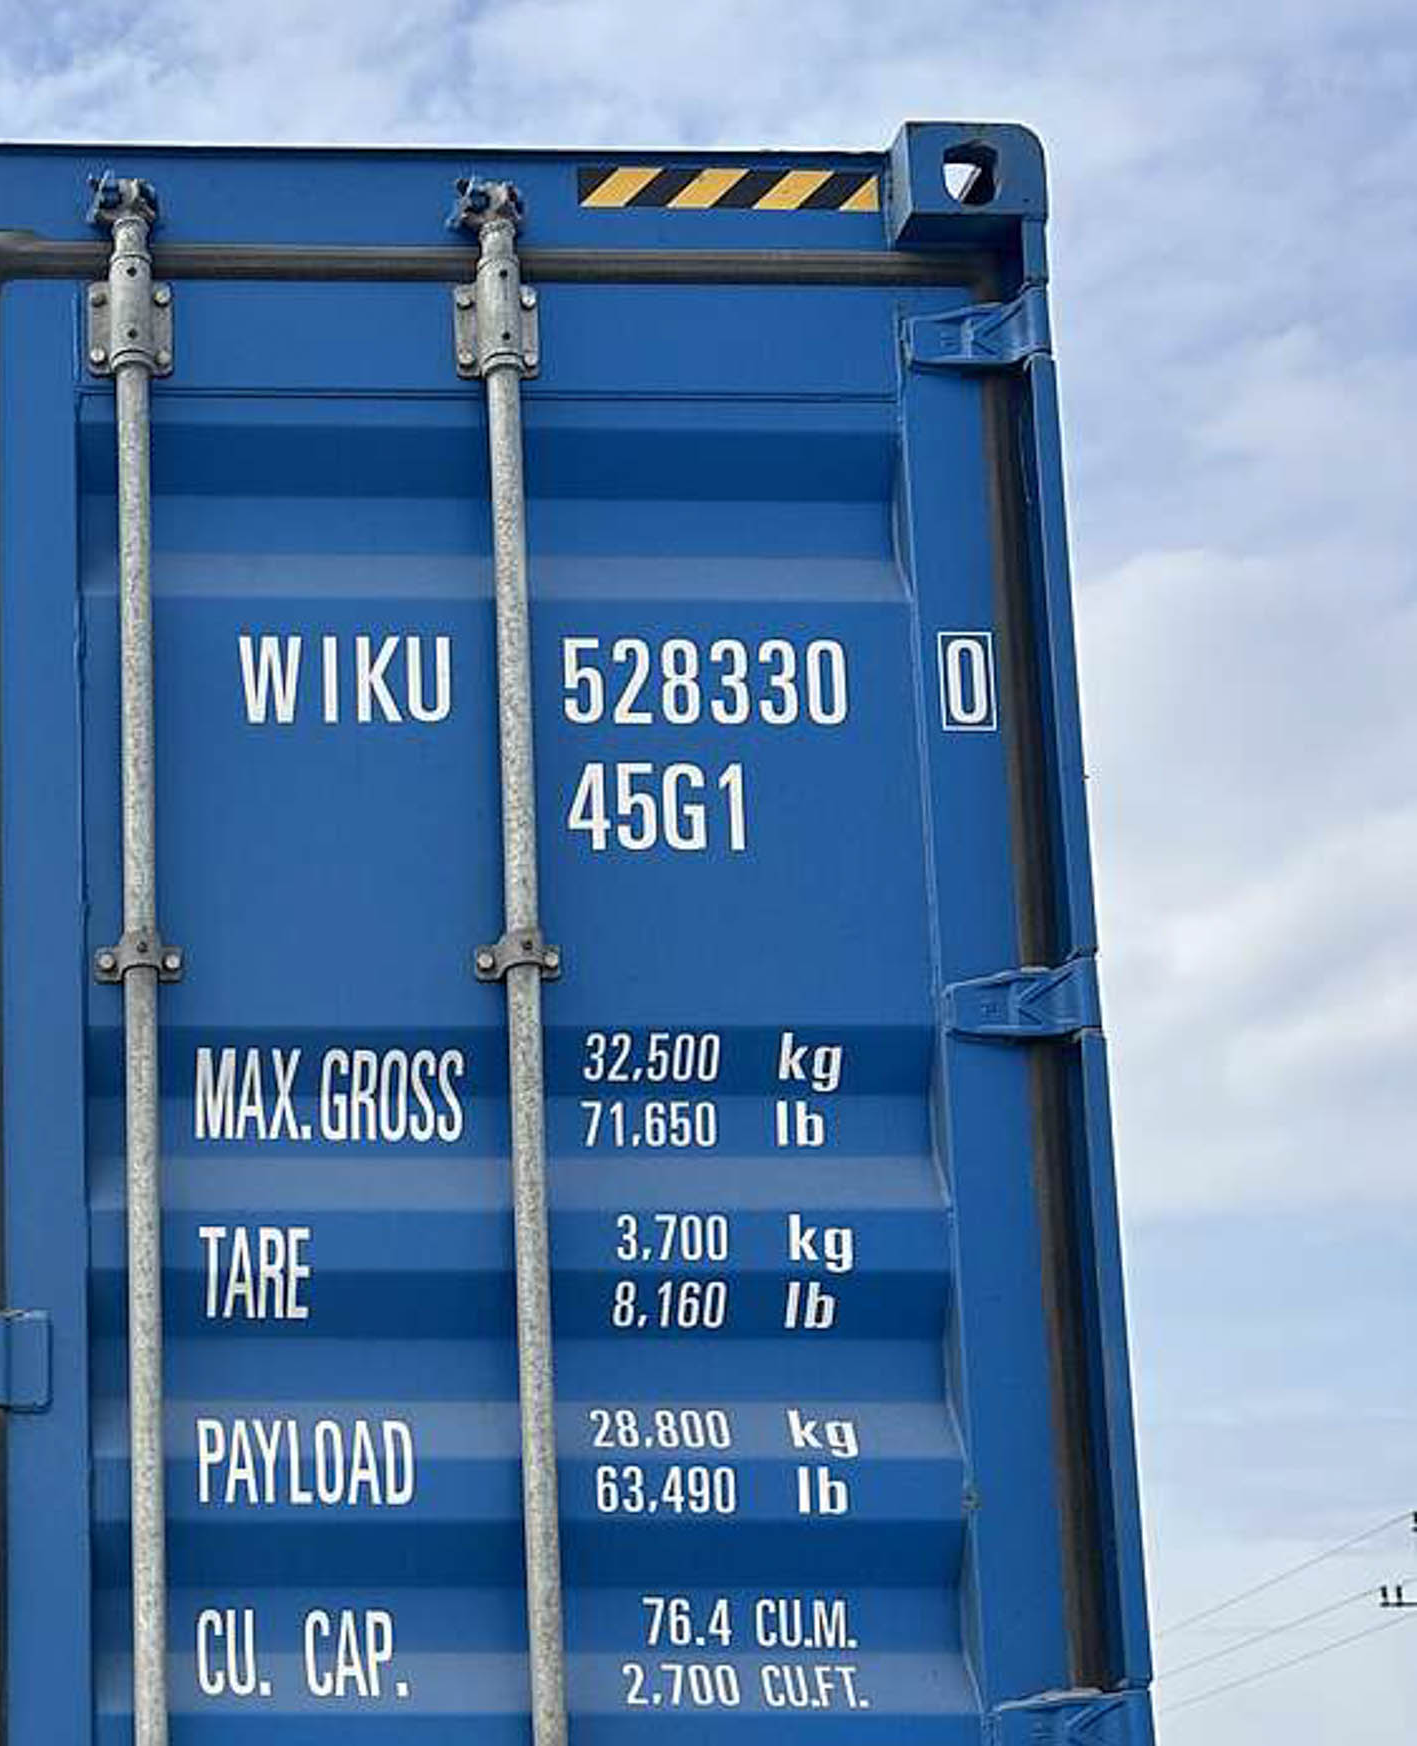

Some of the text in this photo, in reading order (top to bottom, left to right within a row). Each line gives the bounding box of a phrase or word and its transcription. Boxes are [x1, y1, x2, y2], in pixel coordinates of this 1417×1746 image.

[238, 635, 988, 726] WIKU 528330 0
[566, 761, 748, 852] 45G1
[582, 1030, 843, 1094] 32,500 kg
[774, 1099, 826, 1148] lb
[198, 1225, 312, 1320] TARE
[615, 1213, 855, 1275] 3,700 kg
[611, 1279, 836, 1330] 8,160 lb
[195, 1417, 416, 1506] PAYLOAD
[786, 1408, 861, 1460] kg
[595, 1464, 849, 1516] 63,490 lb
[196, 1608, 411, 1698] CU. CAP.
[641, 1597, 859, 1650] 76.4 CU.M.
